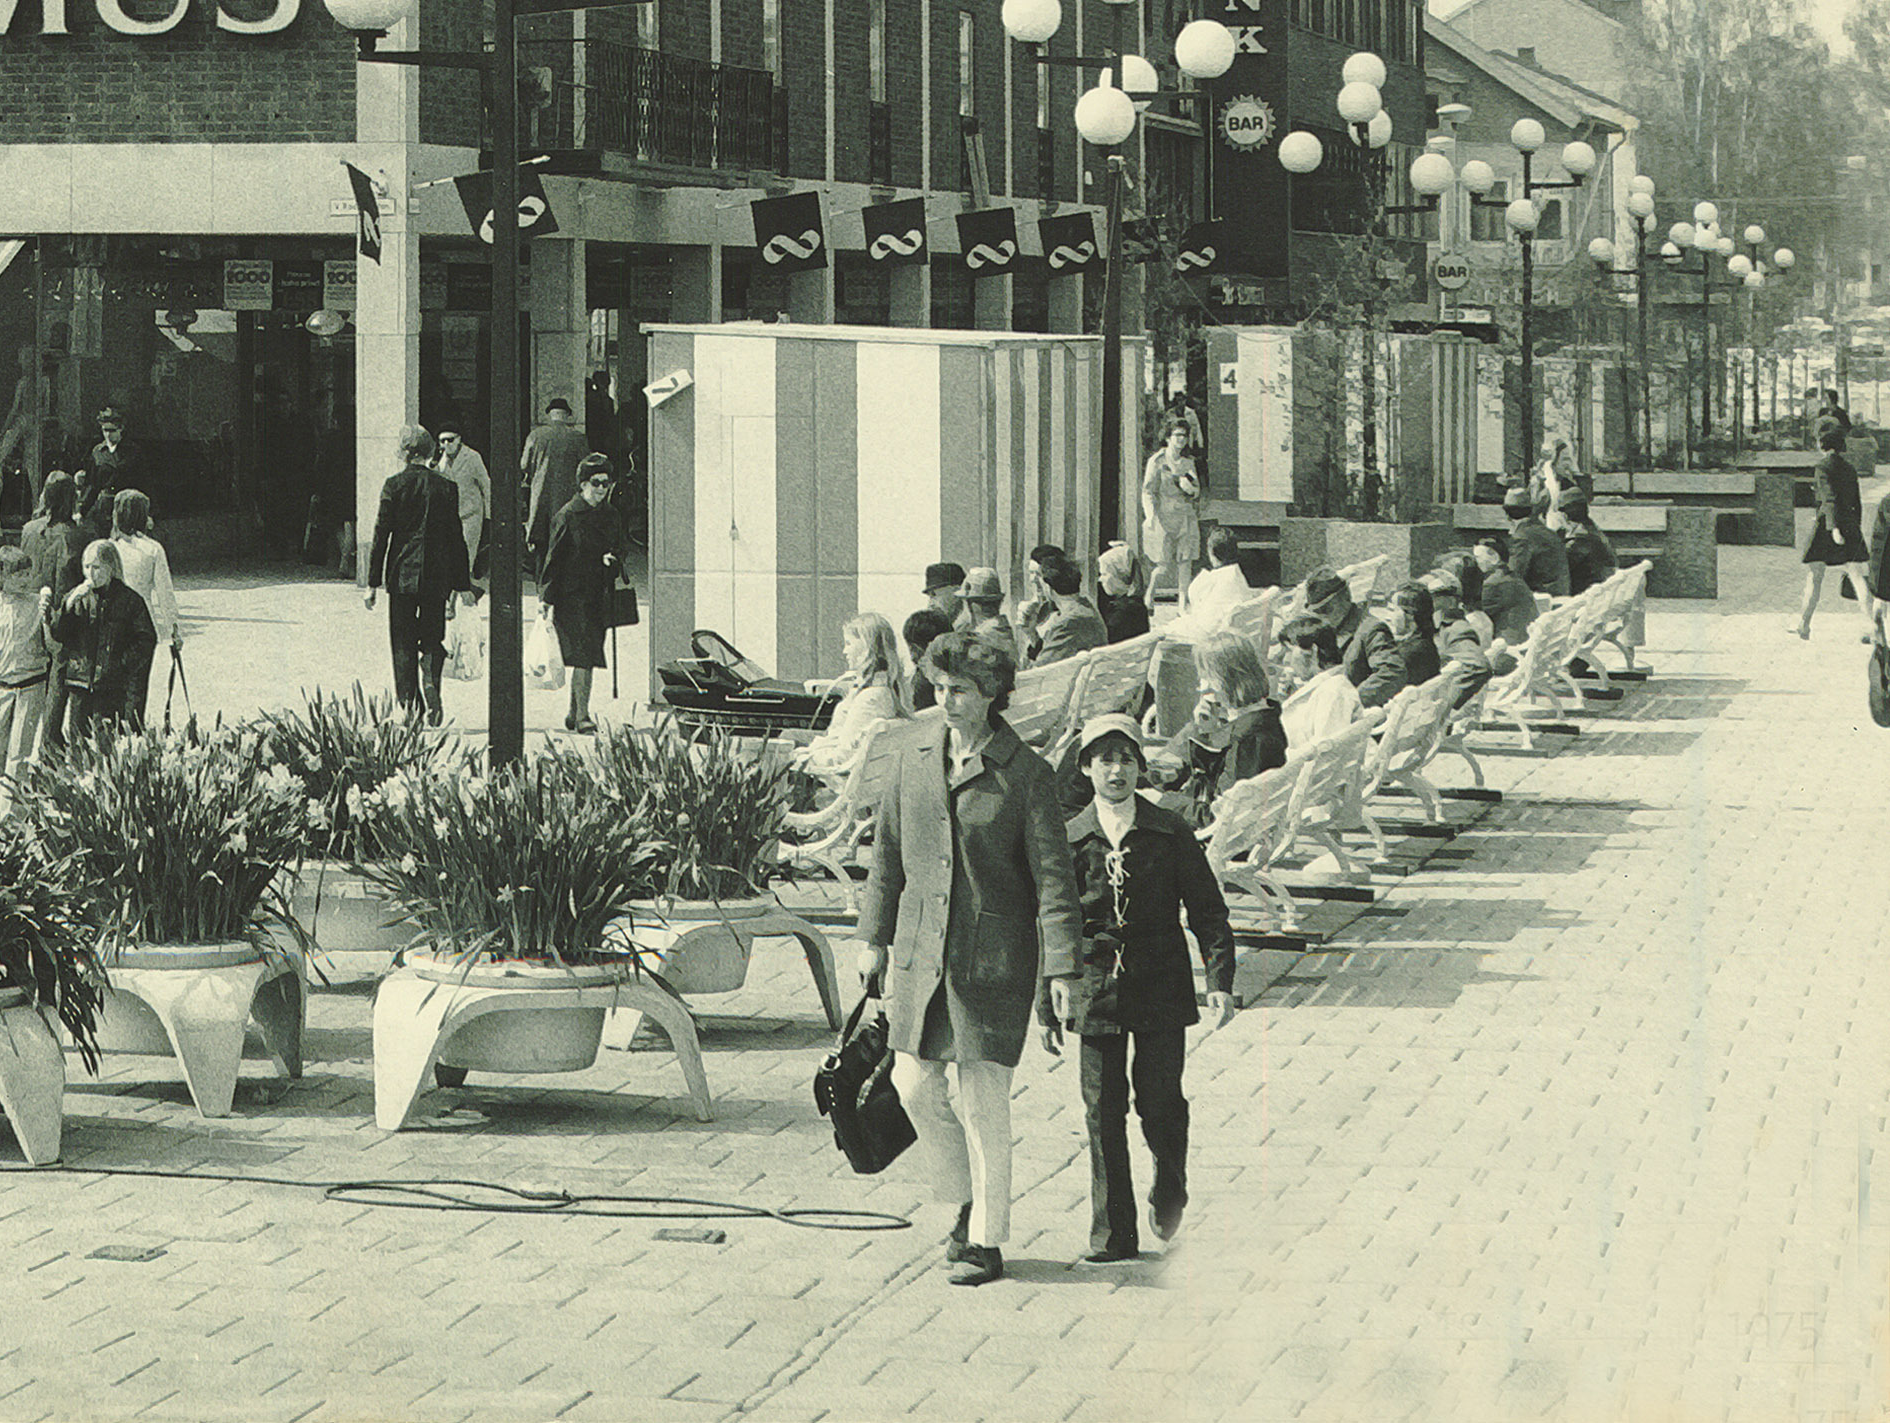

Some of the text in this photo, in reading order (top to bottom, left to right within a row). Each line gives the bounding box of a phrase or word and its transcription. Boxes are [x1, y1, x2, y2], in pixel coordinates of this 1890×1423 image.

[1228, 117, 1264, 130] BAR
[1437, 265, 1468, 278] BAR
[1223, 369, 1237, 389] 4
